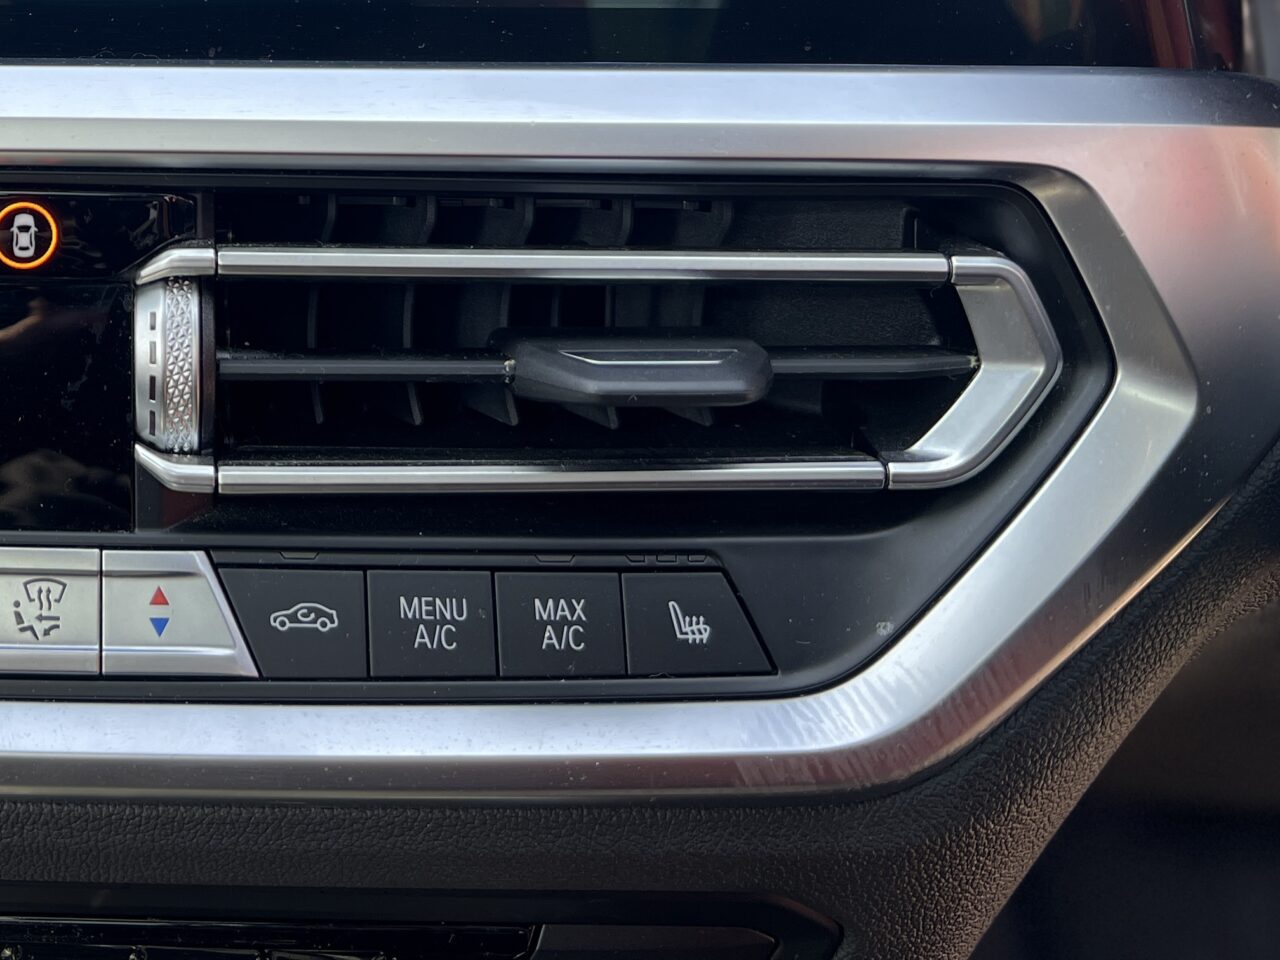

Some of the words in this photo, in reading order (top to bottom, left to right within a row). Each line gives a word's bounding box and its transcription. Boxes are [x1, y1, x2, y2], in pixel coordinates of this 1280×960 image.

[399, 596, 468, 621] MENU
[534, 598, 587, 621] MAX
[414, 624, 457, 650] A/C
[542, 625, 585, 650] A/C
